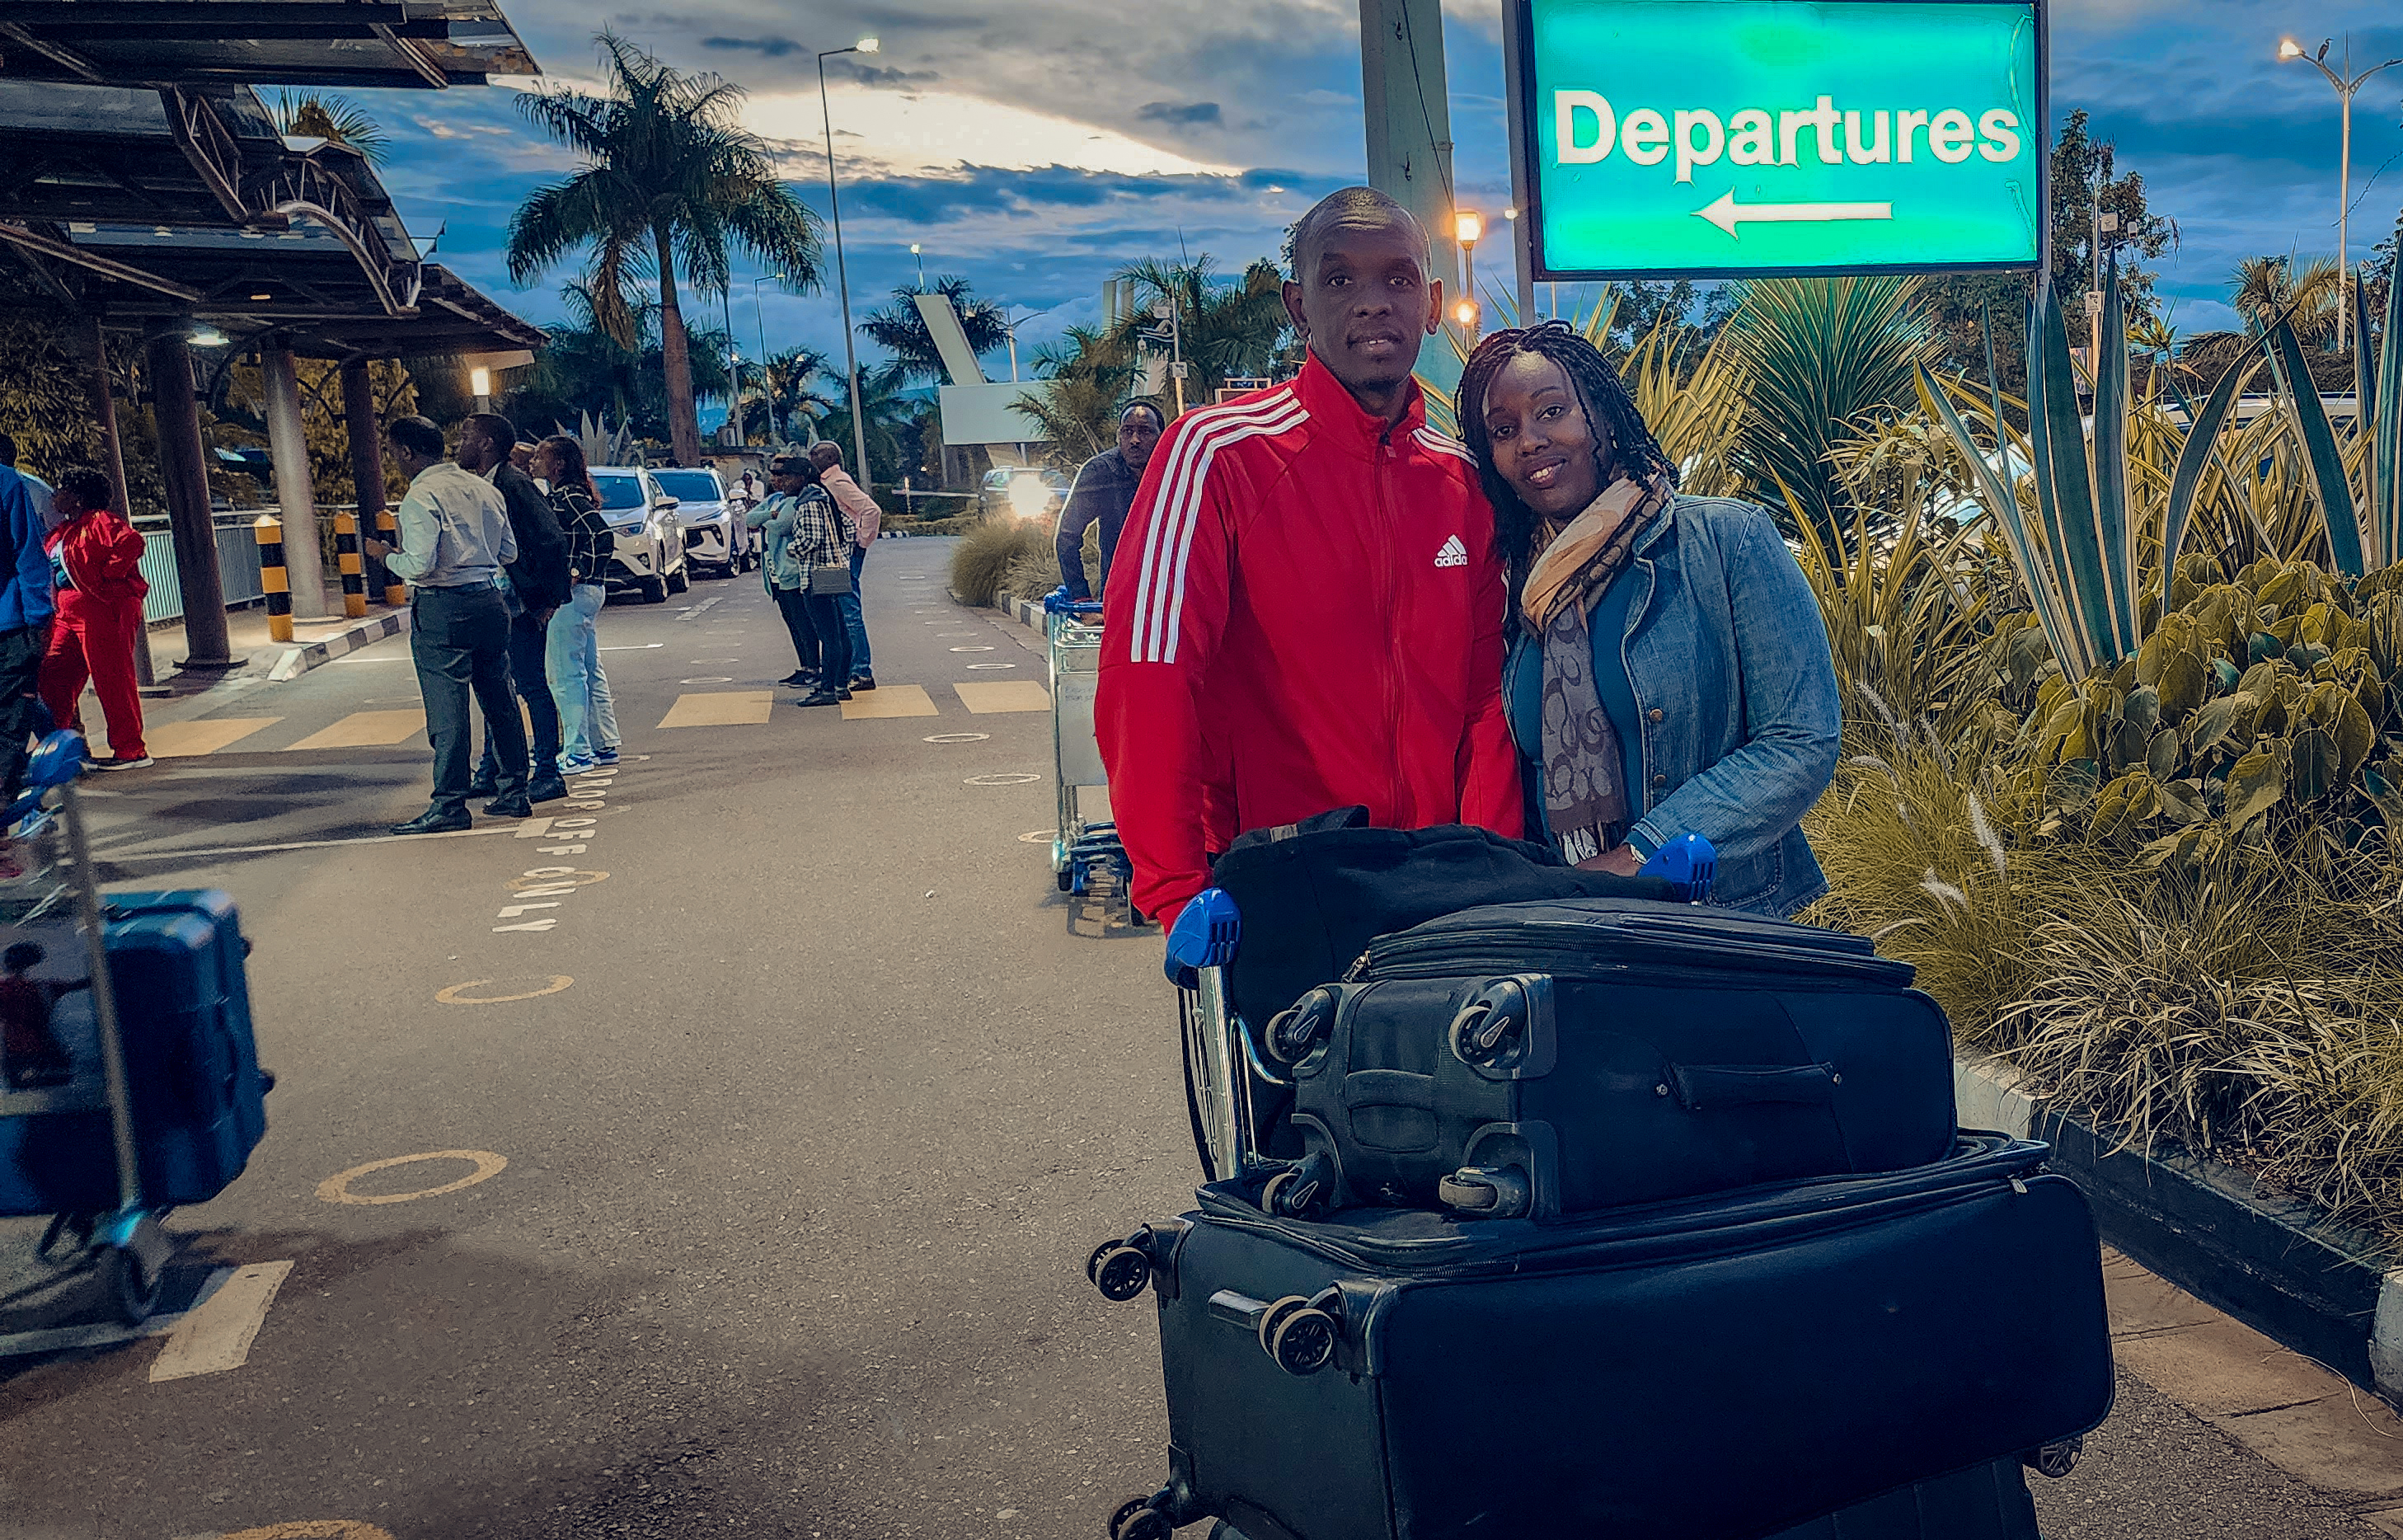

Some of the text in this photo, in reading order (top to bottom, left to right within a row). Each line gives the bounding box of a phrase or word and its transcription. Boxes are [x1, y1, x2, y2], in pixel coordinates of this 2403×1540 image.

[1554, 88, 2021, 184] Departures
[492, 768, 619, 932] DROP OFF ONLY
